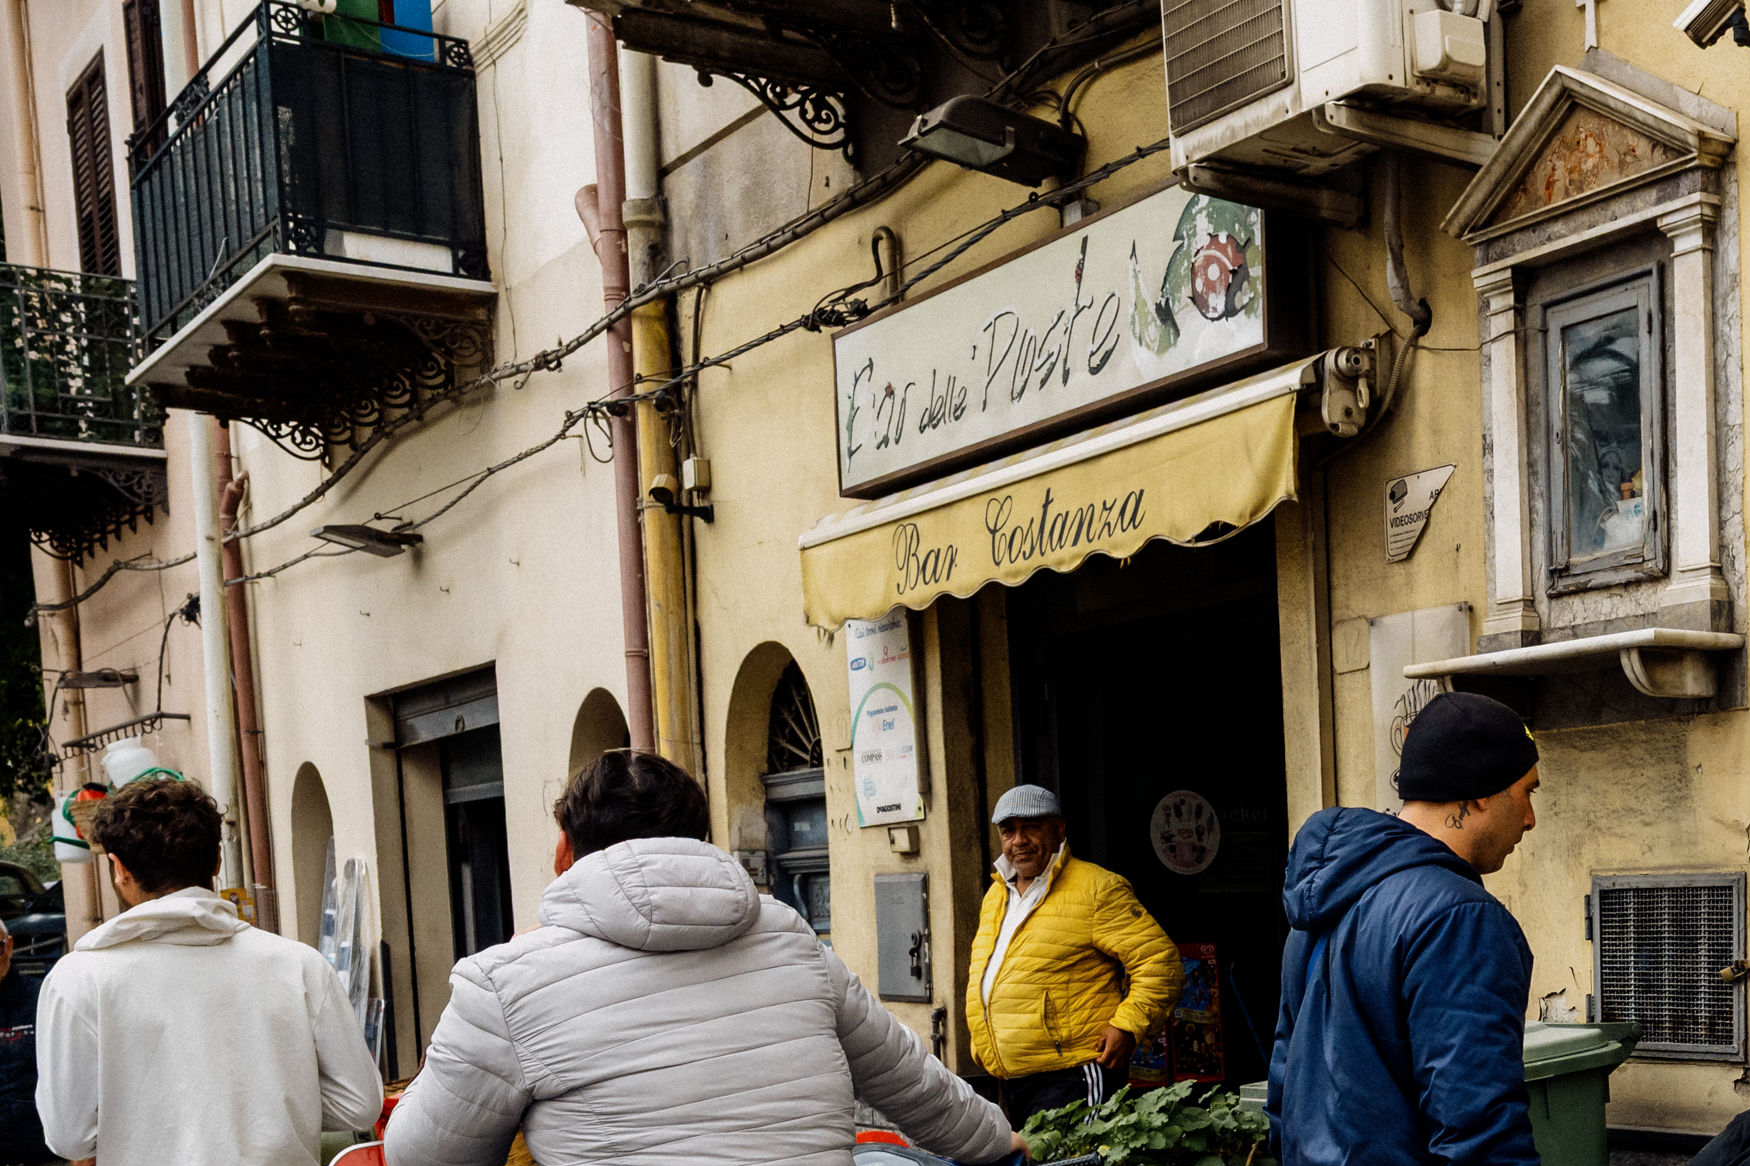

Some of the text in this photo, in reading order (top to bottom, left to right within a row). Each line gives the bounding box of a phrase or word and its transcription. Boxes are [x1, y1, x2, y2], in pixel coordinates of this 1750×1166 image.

[919, 369, 967, 435] delle
[972, 235, 1120, 412] Poste
[892, 487, 1147, 595] Bar Costanza
[882, 718, 895, 731] Enel
[861, 752, 883, 764] COMPASS
